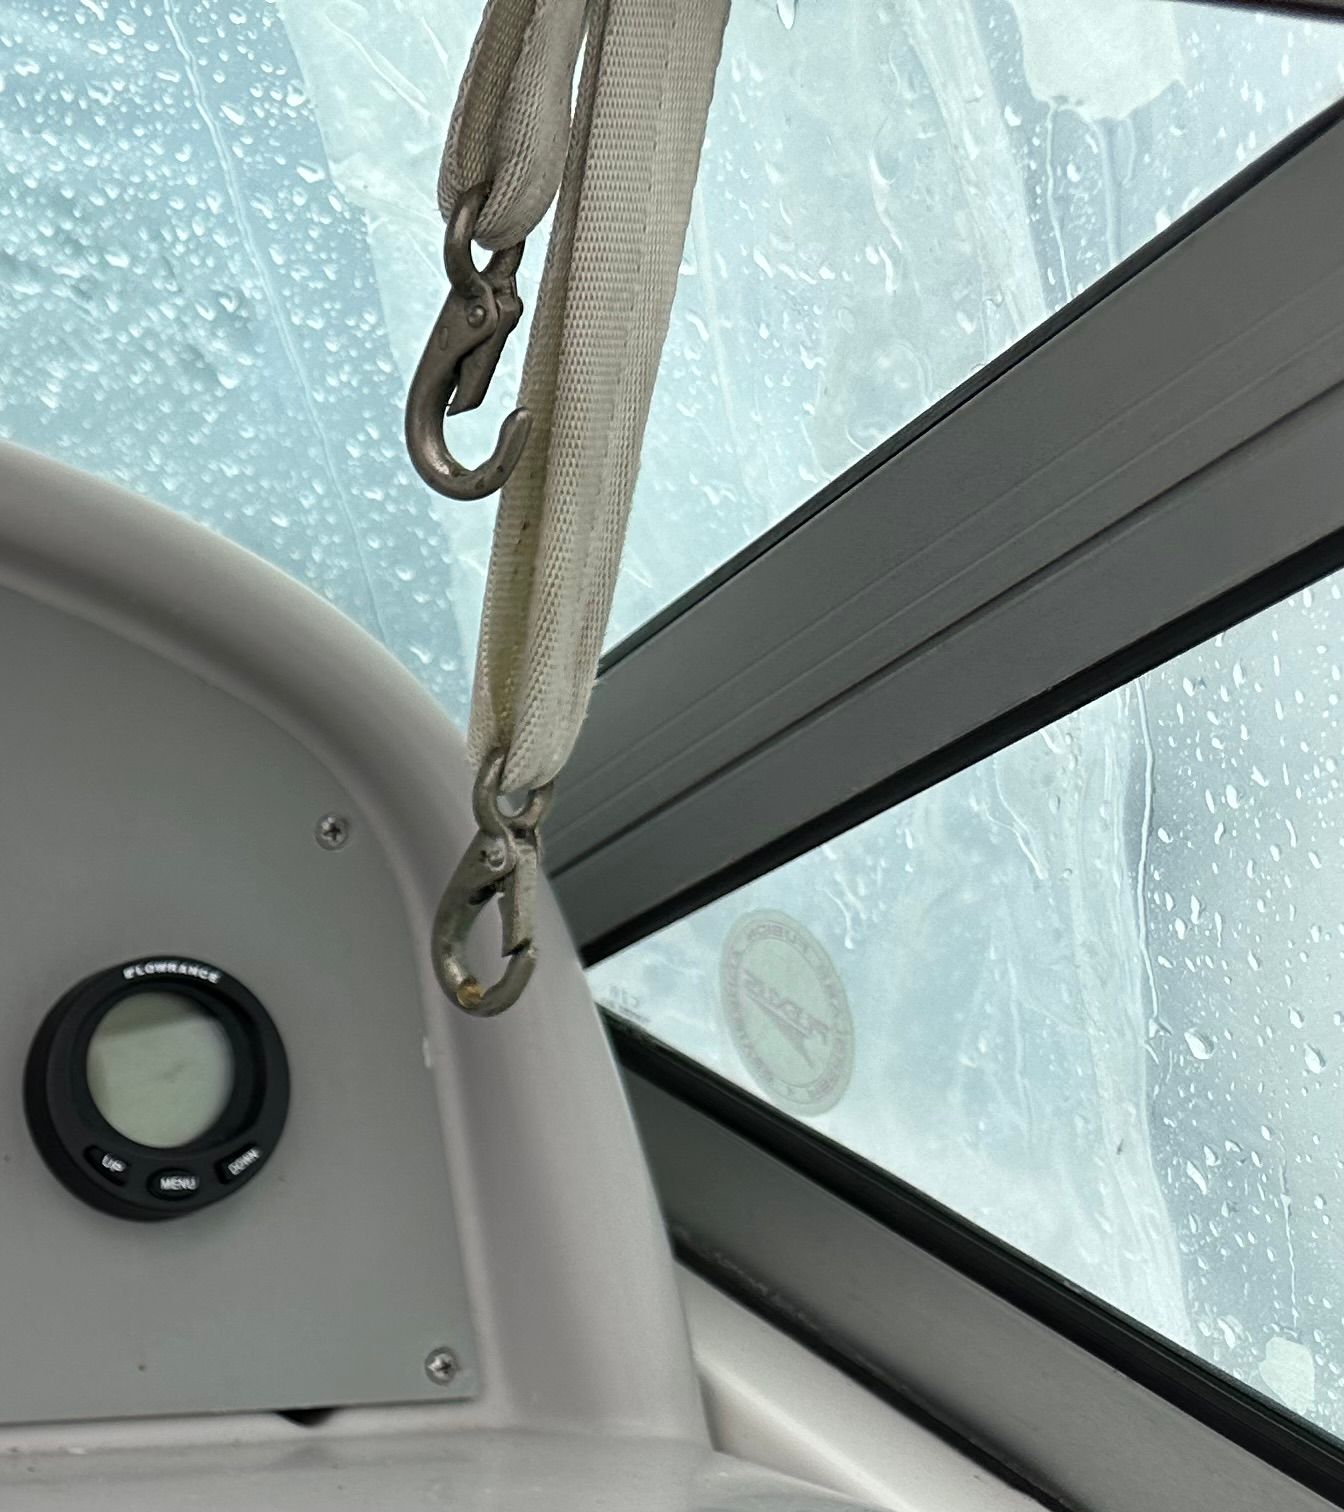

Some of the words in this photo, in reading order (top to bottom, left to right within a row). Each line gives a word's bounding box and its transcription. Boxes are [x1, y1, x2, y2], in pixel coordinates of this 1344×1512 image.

[135, 962, 221, 983] LOWRANCE
[102, 1154, 127, 1173] UP
[160, 1176, 198, 1190] MENU
